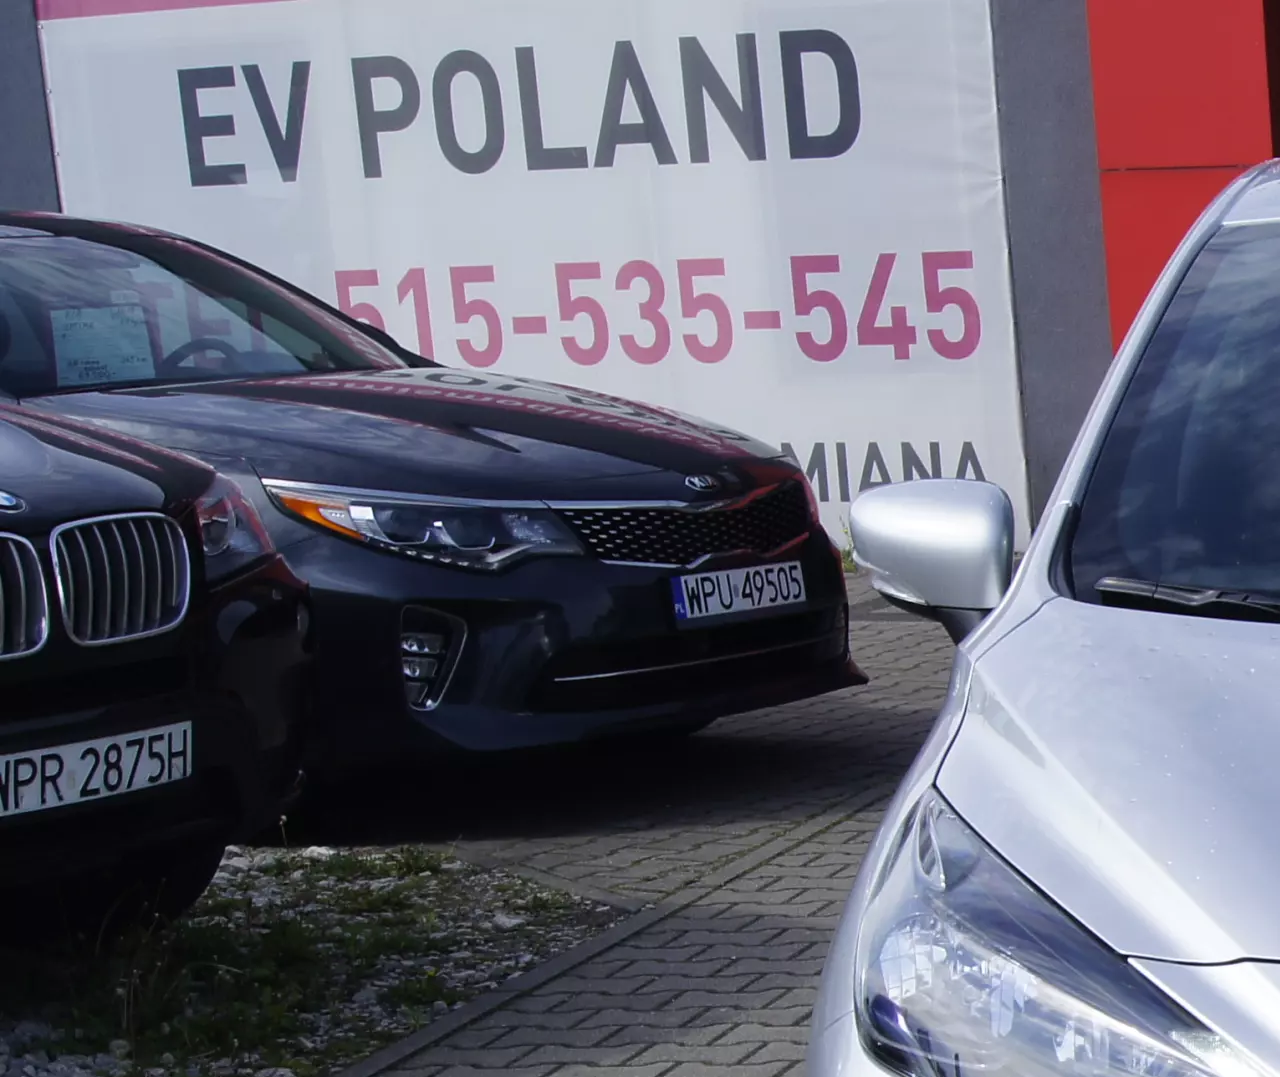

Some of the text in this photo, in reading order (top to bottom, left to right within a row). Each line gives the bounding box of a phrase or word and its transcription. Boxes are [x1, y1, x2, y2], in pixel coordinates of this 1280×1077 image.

[177, 28, 862, 187] EV POLAND
[334, 250, 982, 367] 515-535-545
[684, 564, 801, 616] WPU 49505
[79, 729, 187, 798] 2875H
